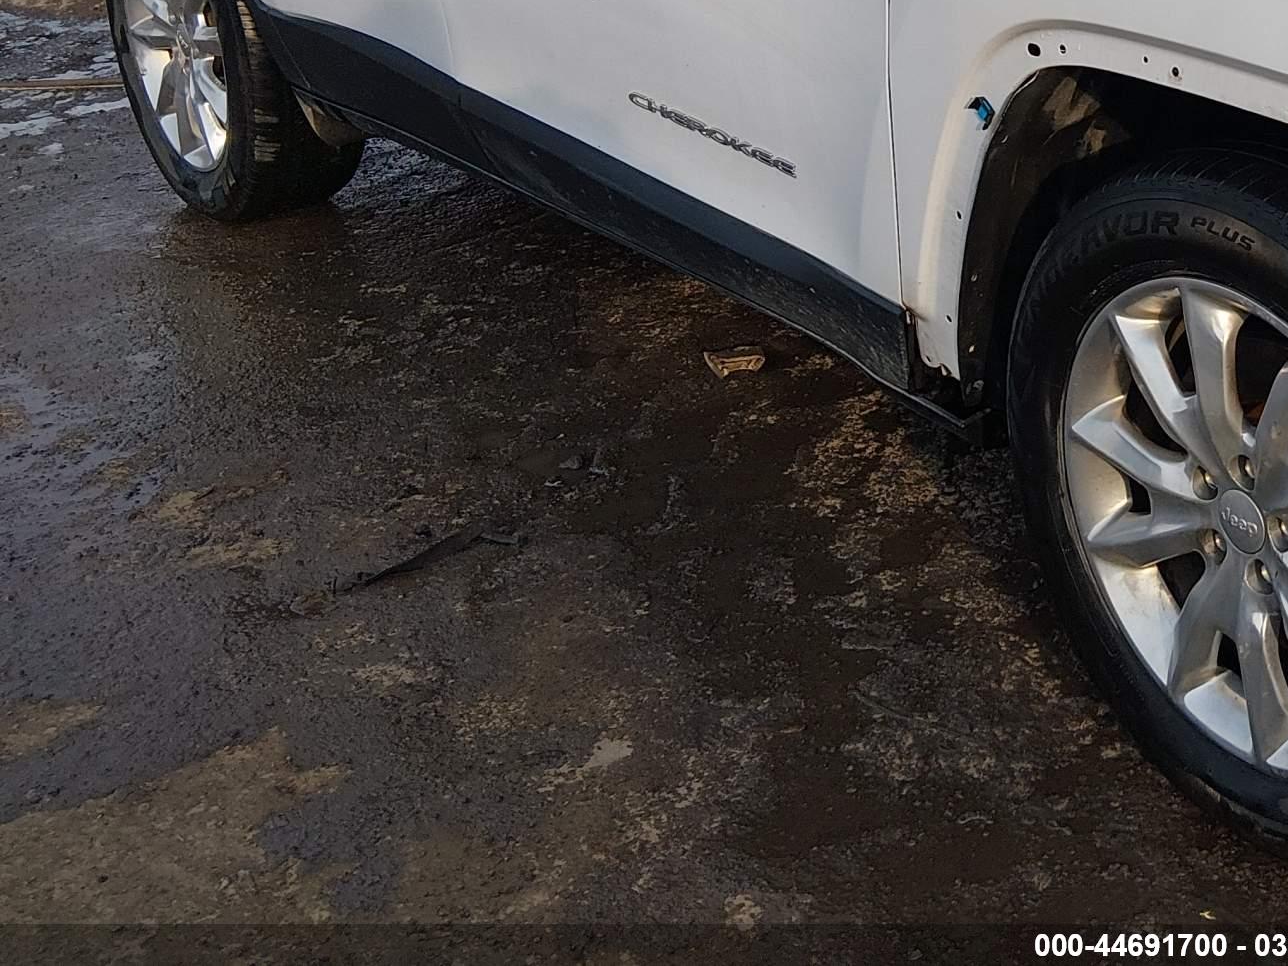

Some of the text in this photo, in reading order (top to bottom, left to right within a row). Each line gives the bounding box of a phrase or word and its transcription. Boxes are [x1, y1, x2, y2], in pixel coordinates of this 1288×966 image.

[628, 91, 798, 179] CHEROKEE
[1190, 214, 1256, 253] PLUS
[1221, 506, 1258, 538] Jeep
